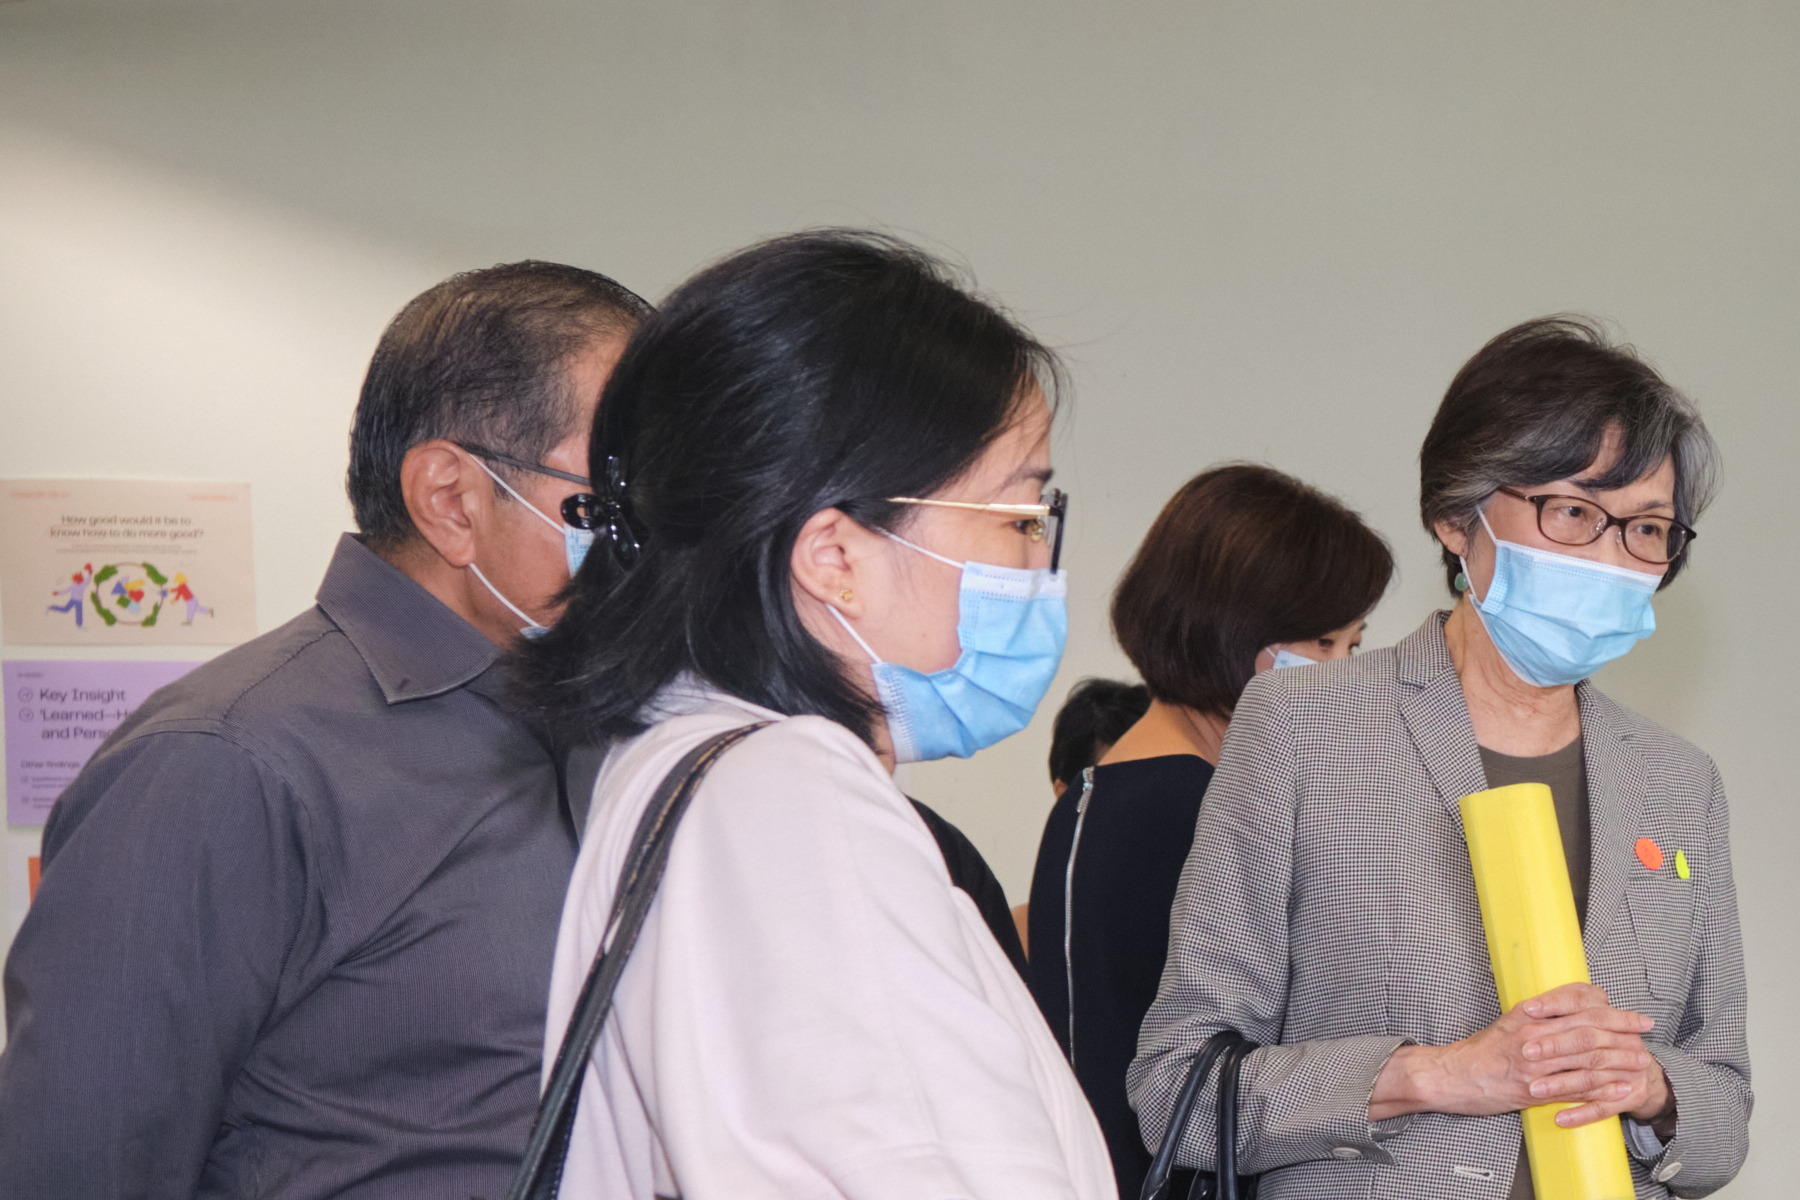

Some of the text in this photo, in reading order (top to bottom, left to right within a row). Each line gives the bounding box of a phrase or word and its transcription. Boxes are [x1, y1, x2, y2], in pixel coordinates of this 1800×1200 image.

[61, 515, 87, 525] How
[89, 514, 117, 526] good
[119, 515, 153, 525] would
[180, 516, 192, 525] to
[50, 528, 80, 538] know
[82, 528, 106, 538] how
[122, 528, 137, 538] do
[138, 529, 168, 538] more
[40, 688, 126, 704] Key Insight
[41, 727, 70, 739] and
